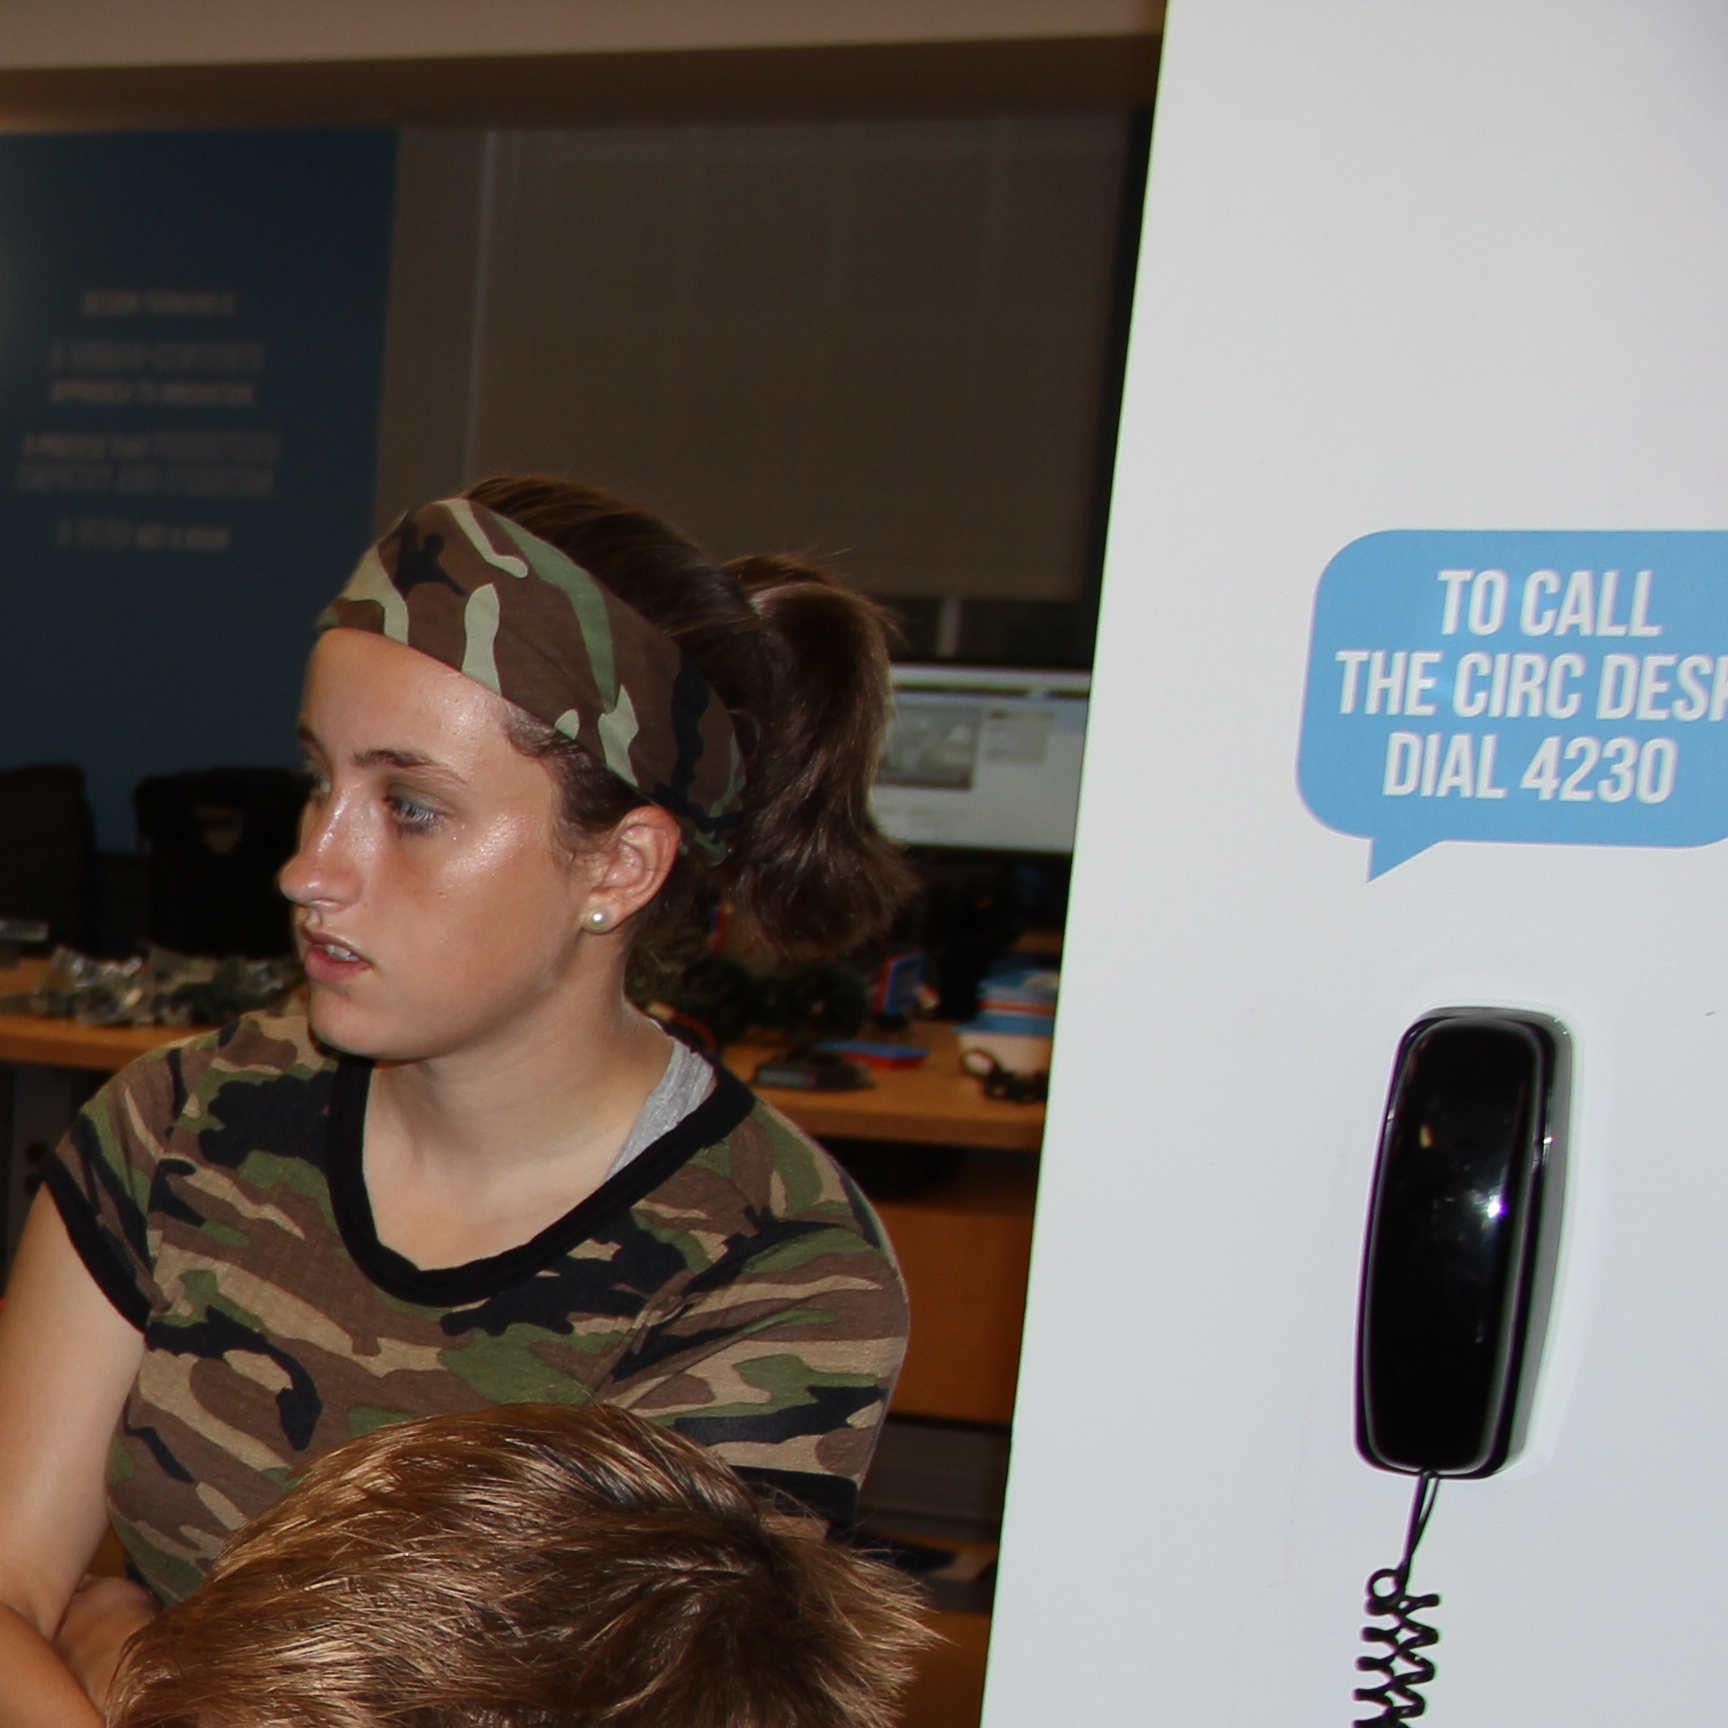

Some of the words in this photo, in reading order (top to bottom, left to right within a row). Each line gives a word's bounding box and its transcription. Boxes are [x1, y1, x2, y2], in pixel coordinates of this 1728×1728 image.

[1436, 568, 1509, 637] TO
[1519, 568, 1664, 638] CALL
[1334, 648, 1443, 717] THE
[1452, 652, 1586, 721] CIRC
[1382, 731, 1509, 800] DIAL
[1520, 735, 1680, 805] 4230
